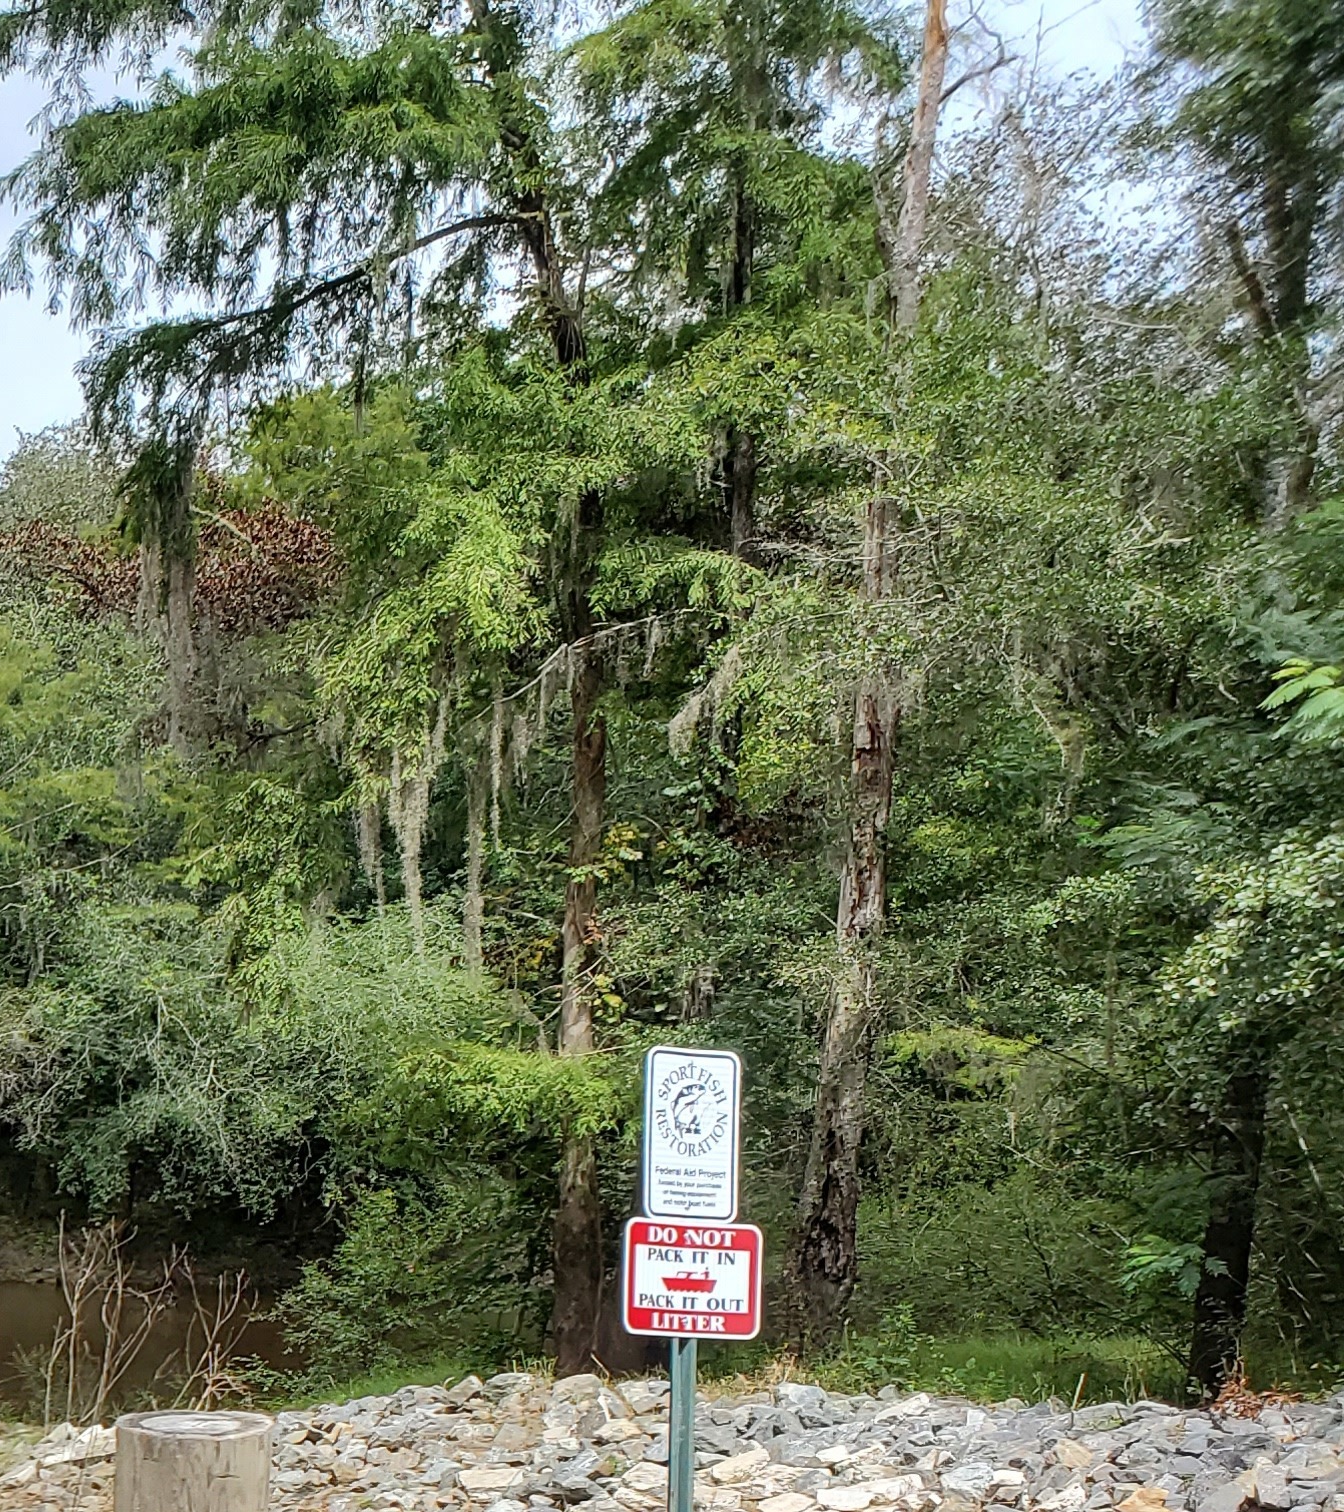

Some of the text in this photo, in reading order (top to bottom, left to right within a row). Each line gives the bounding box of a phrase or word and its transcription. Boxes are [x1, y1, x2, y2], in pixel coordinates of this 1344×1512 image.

[658, 1064, 727, 1105] SPORT FISH
[655, 1109, 728, 1157] RESTORATION
[655, 1166, 726, 1180] Federal Aid Project
[647, 1226, 736, 1247] DO NOT
[647, 1248, 736, 1265] PACK IT IN
[639, 1293, 744, 1311] PACK IT OUT
[651, 1312, 726, 1332] LITTER
